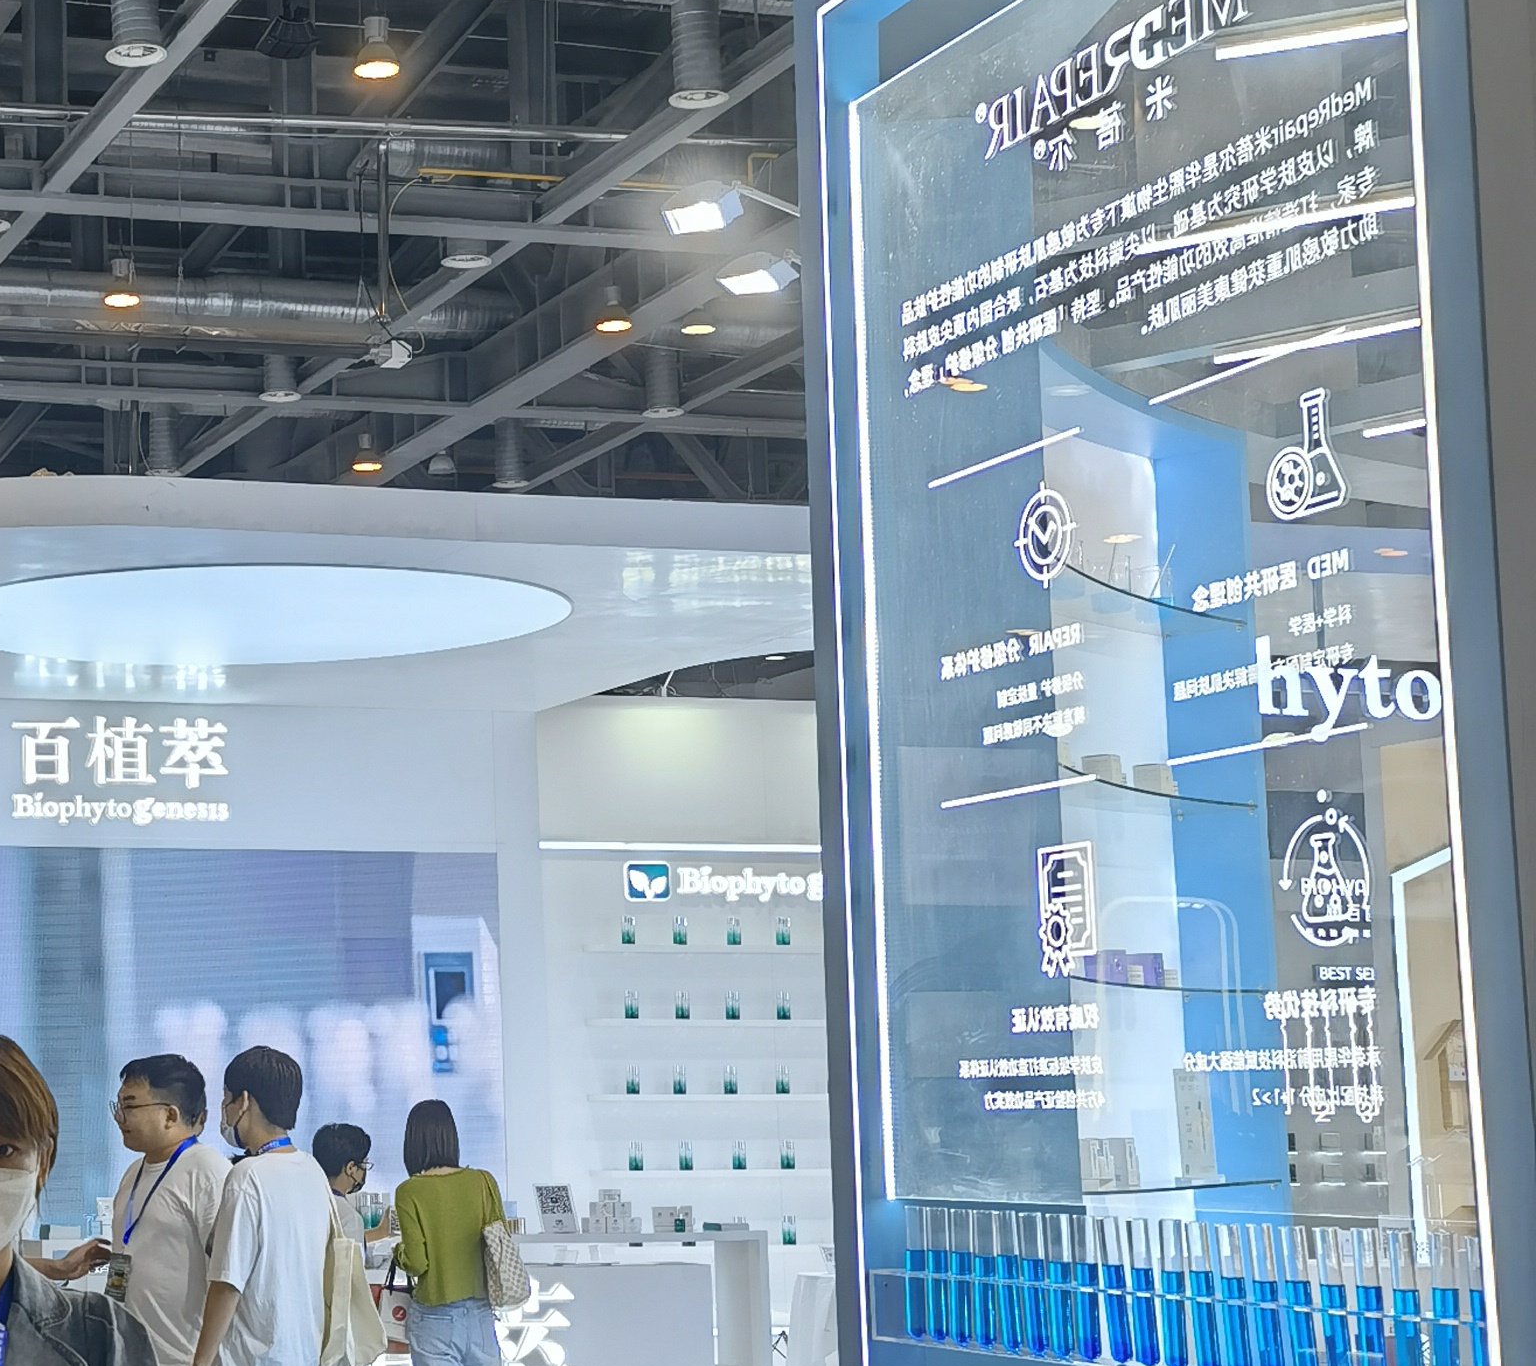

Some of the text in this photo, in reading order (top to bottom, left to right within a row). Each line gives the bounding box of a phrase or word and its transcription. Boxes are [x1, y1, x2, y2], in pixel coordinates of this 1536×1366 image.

[11, 716, 230, 788] 百植萃
[1319, 966, 1352, 981] BEST
